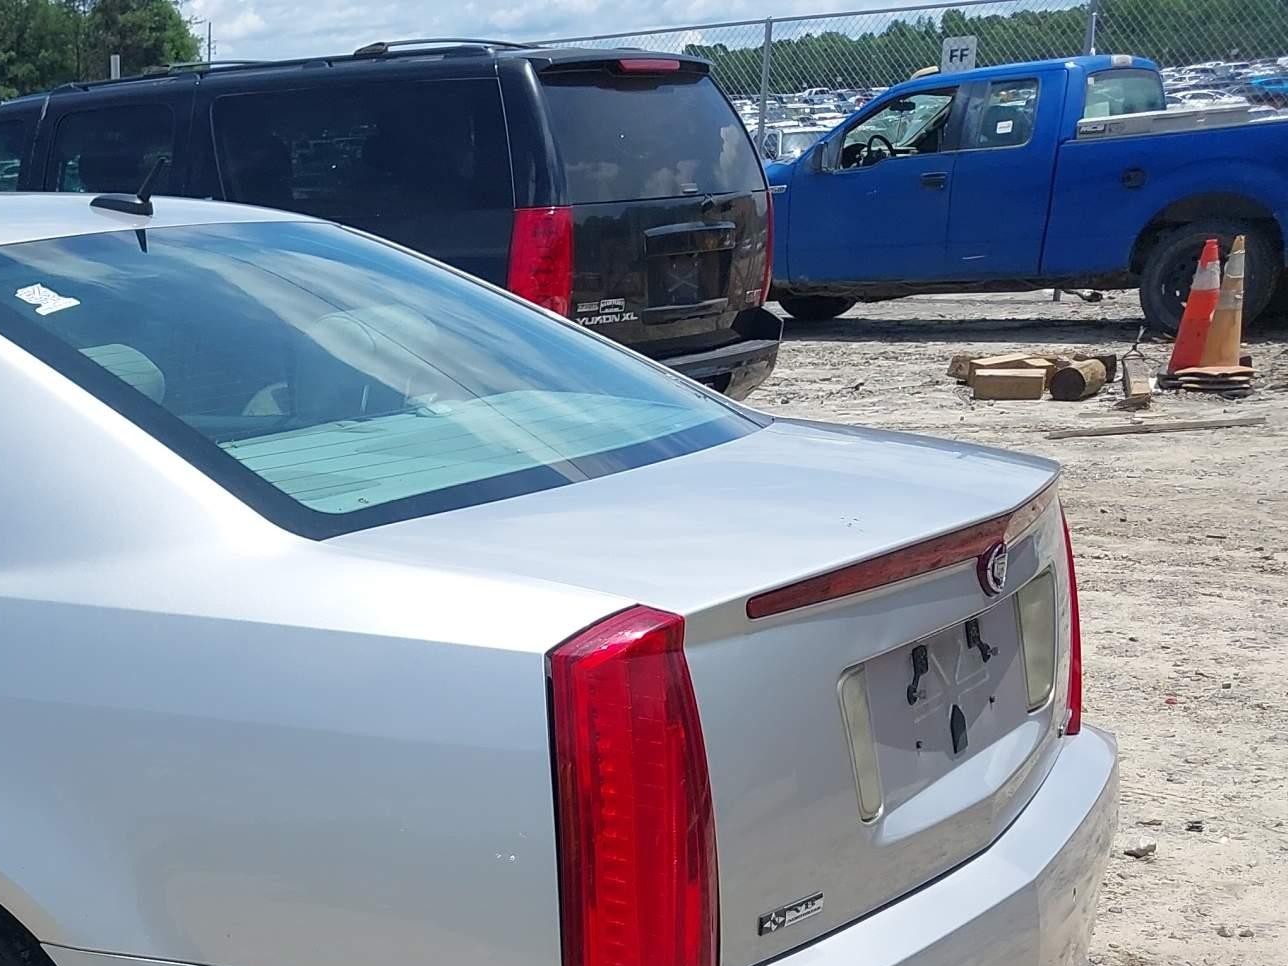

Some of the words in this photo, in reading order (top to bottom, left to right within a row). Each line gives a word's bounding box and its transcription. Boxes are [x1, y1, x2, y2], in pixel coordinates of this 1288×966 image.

[949, 47, 969, 63] FF
[576, 314, 620, 326] YUKON
[621, 312, 638, 322] XL
